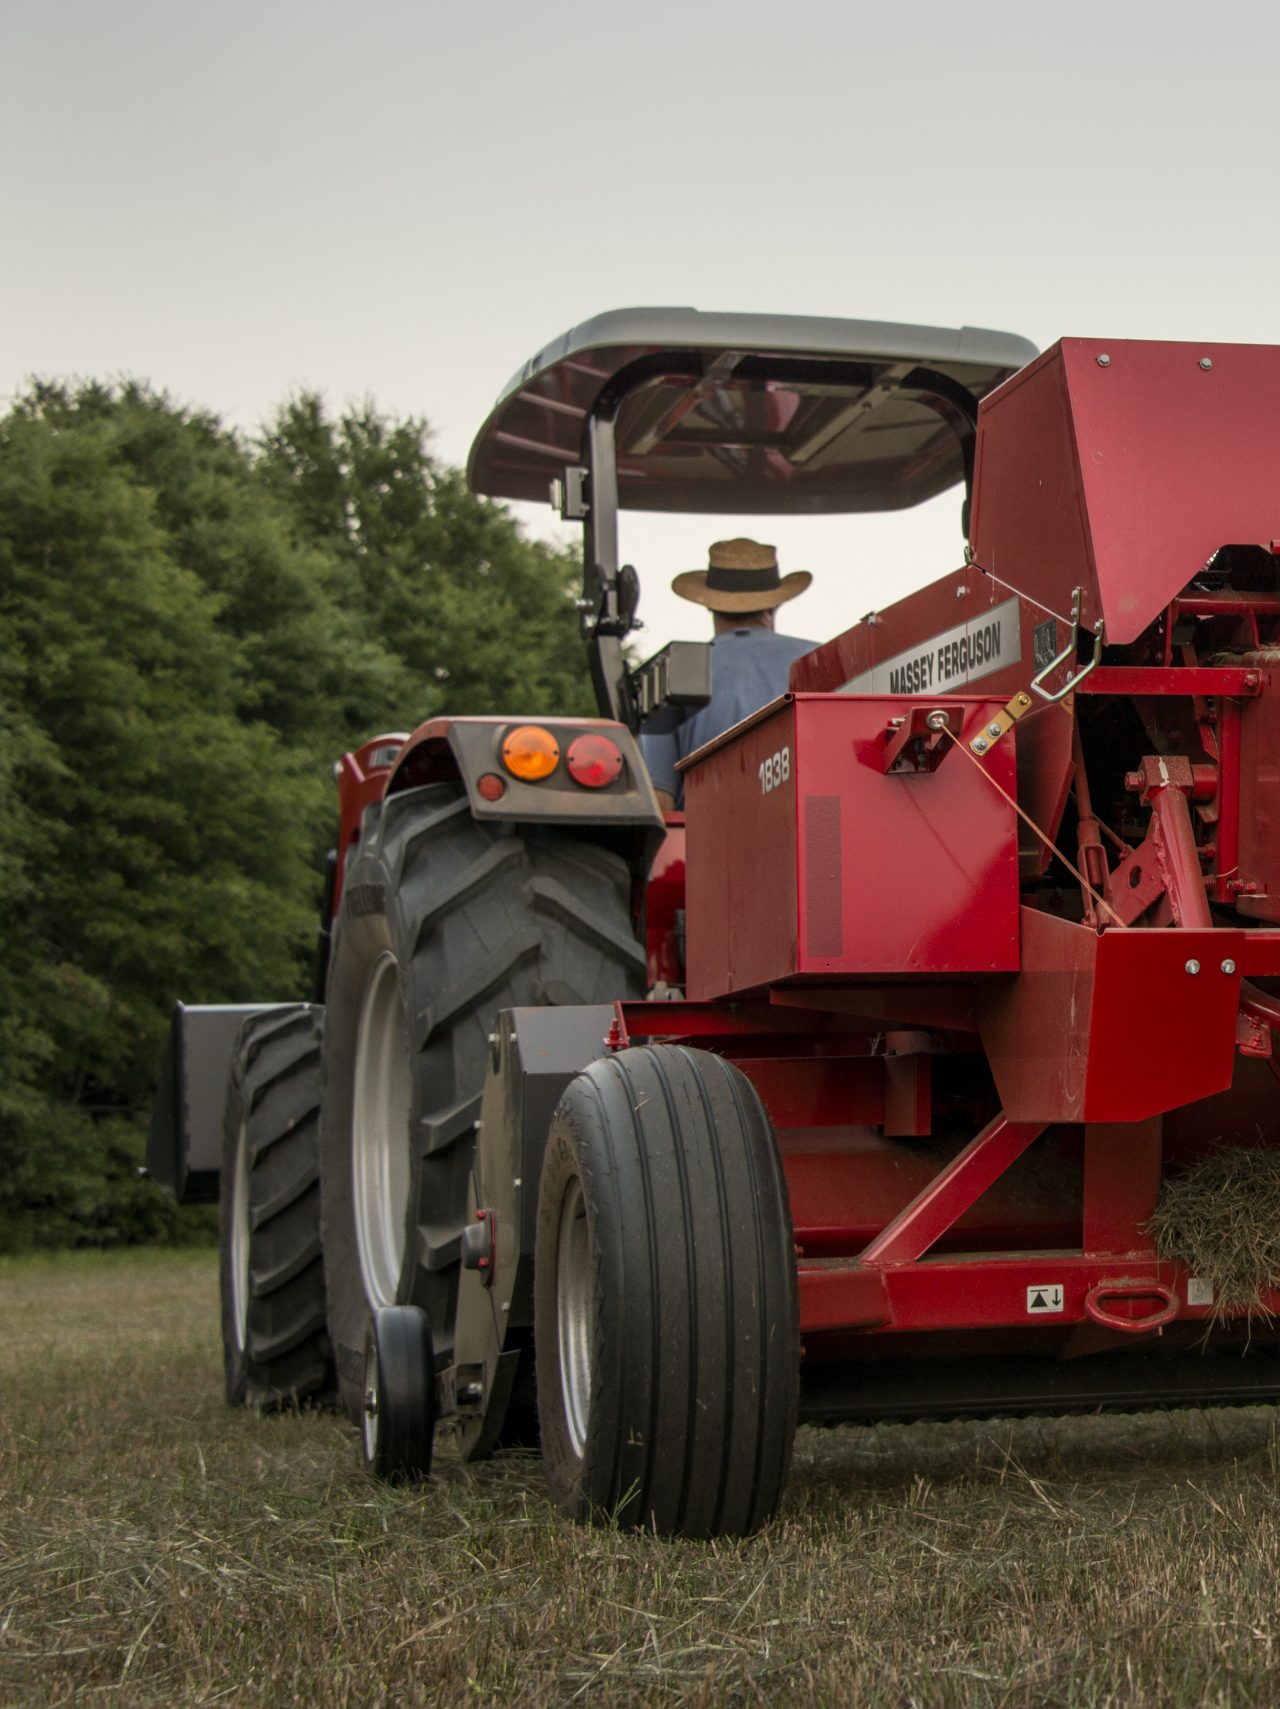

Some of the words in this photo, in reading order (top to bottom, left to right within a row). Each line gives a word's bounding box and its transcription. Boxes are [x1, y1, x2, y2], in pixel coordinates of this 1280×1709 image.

[889, 652, 935, 695] MASSEY
[937, 621, 1000, 683] FERGUSON
[759, 746, 790, 795] 1838
